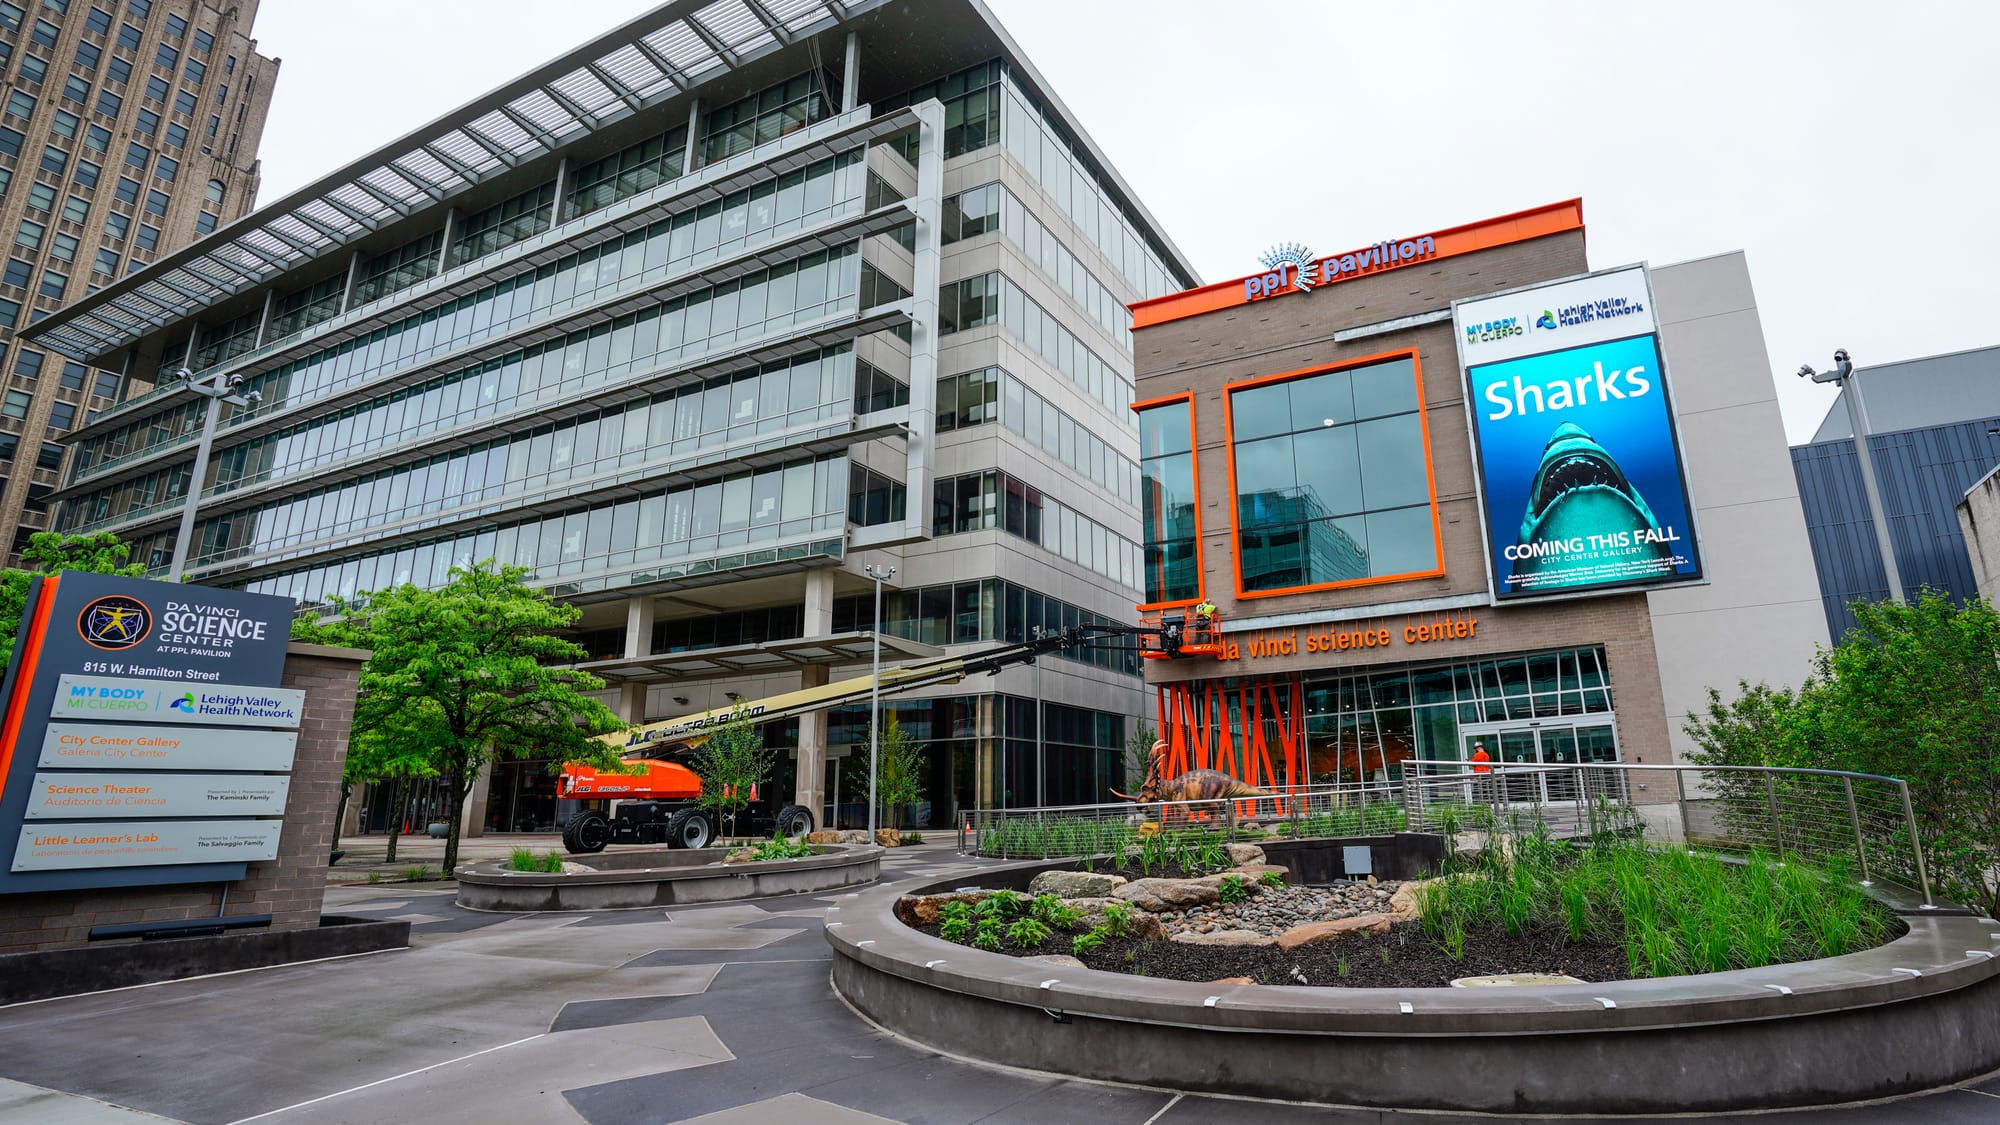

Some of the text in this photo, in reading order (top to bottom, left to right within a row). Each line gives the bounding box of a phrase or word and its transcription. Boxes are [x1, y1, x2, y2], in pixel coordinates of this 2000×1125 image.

[1244, 235, 1435, 300] ppl pavilion
[1558, 297, 1628, 319] Lehigh Valley
[1559, 303, 1644, 328] Health Network
[1466, 317, 1517, 336] MY BODY
[1467, 326, 1523, 345] MI CUERPO
[1485, 360, 1650, 421] Sharks
[1504, 526, 1681, 561] COMING THIS FALL
[1541, 546, 1643, 565] CITY CENTER GALLERY
[166, 601, 240, 618] DA VINCI
[161, 611, 268, 641] SCIENCE
[159, 633, 234, 648] CENTER
[1248, 632, 1298, 658] vinci
[1306, 628, 1391, 653] science
[1403, 617, 1478, 644] center
[157, 645, 232, 658] AT PPL PAVILION
[83, 661, 220, 681] 815 W. Hamilton Street
[71, 686, 145, 700] MY BODY
[67, 698, 149, 712] MI CUERPO
[201, 693, 282, 709] Lehigh Valley
[199, 704, 294, 719] Health Network
[60, 734, 181, 749] City Center Gallery
[104, 748, 127, 759] City
[129, 748, 169, 758] Center
[47, 784, 152, 795] Science Theater
[575, 785, 592, 793] JLG
[105, 796, 121, 806] de
[125, 796, 167, 806] Ciencia
[249, 794, 271, 802] Family
[34, 833, 159, 847] Little Learner's Lab
[243, 840, 265, 848] Family
